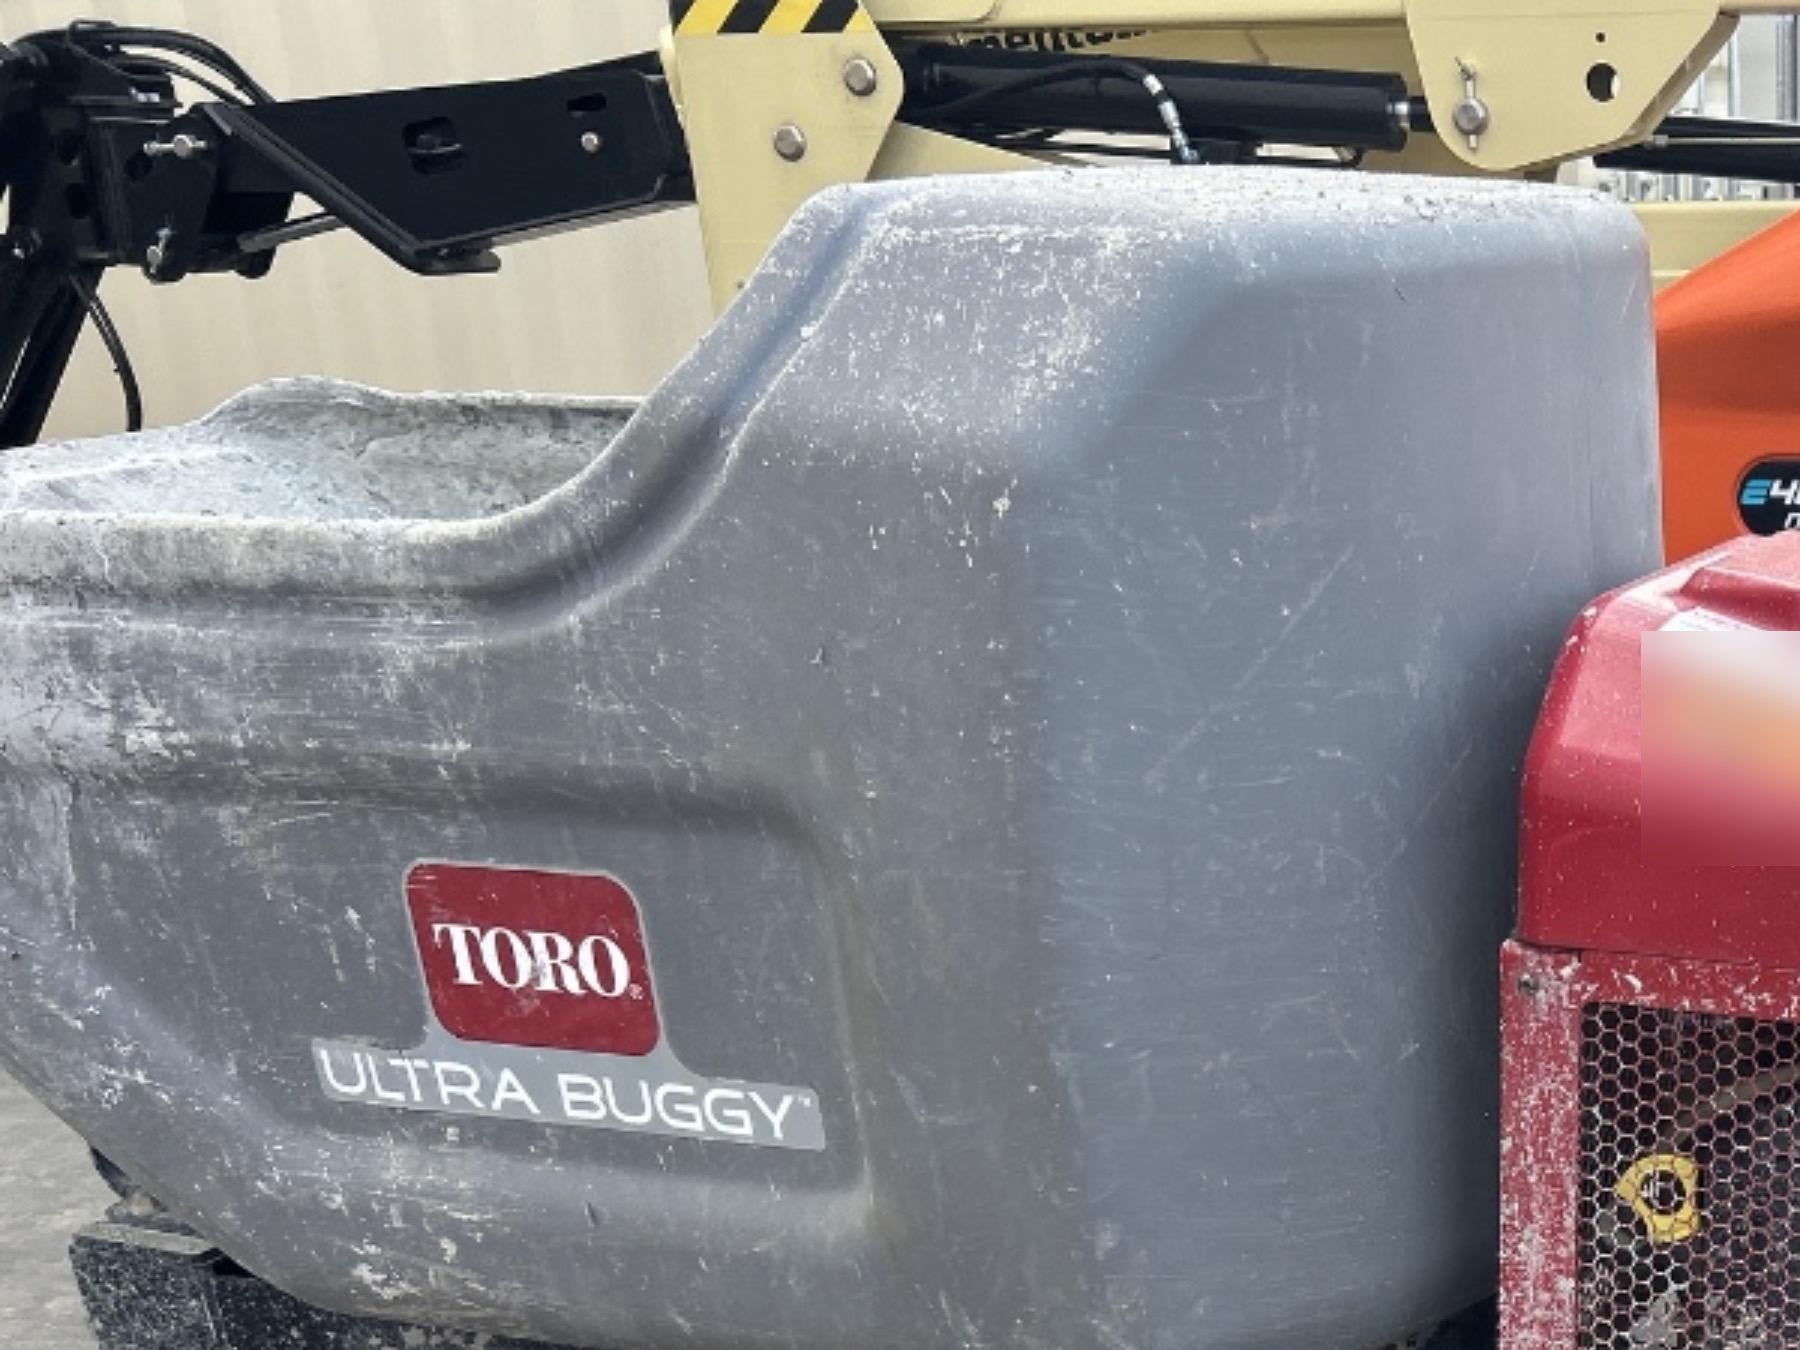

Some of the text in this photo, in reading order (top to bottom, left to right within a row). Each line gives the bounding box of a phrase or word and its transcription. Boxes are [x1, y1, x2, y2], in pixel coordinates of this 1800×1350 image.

[432, 922, 633, 999] TORO
[320, 1049, 798, 1141] ULTRA BUGGY
